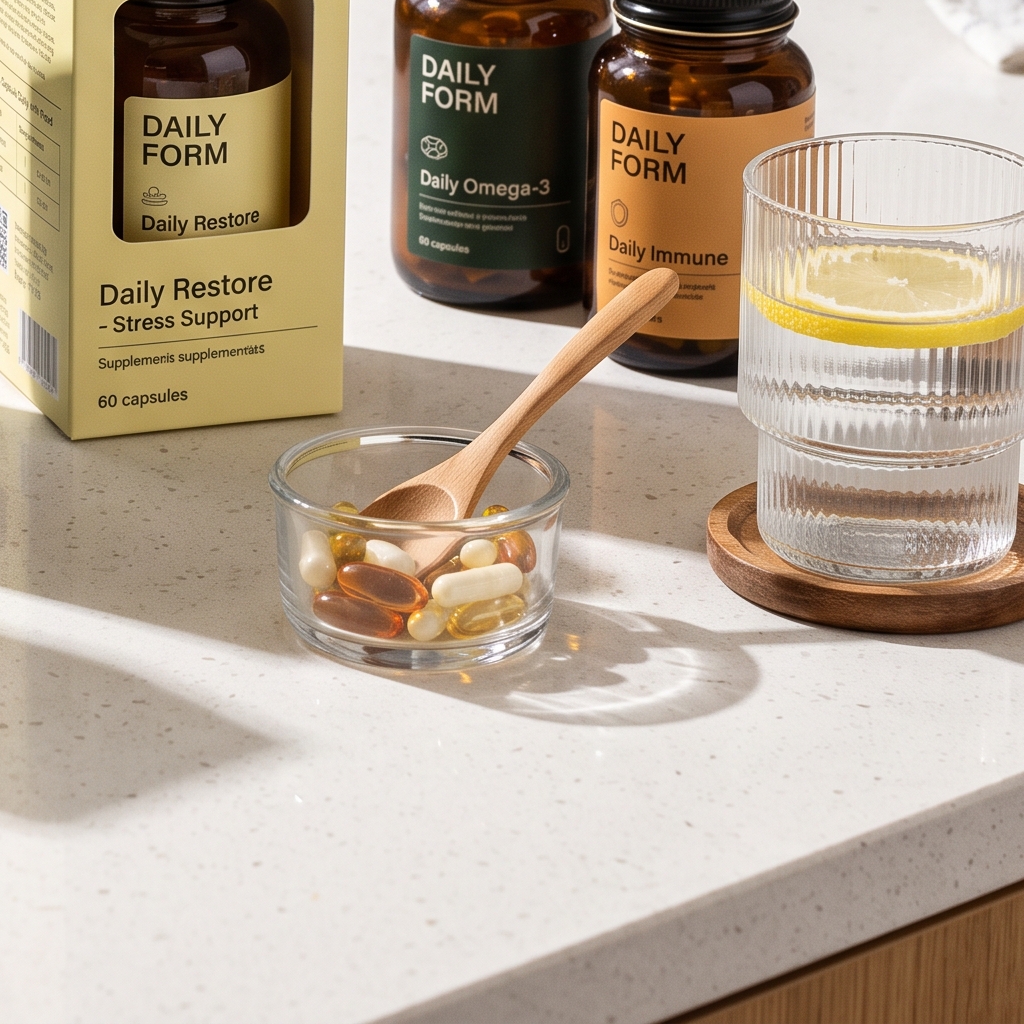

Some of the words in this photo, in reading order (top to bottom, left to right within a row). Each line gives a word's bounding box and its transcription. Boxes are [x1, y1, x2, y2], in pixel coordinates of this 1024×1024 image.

[421, 53, 496, 86] DAILY
[421, 81, 498, 114] FORM
[143, 113, 227, 138] DAILY
[612, 120, 685, 155] DAILY
[142, 141, 227, 167] FORM
[611, 149, 687, 184] FORM
[420, 169, 459, 196] Daily
[463, 178, 551, 201] Omega-3
[141, 214, 188, 236] Daily
[194, 210, 260, 231] Restore
[609, 234, 646, 263] Daily
[651, 245, 729, 266] Immune
[100, 280, 165, 309] Daily
[173, 274, 273, 301] Restore
[113, 315, 175, 333] Stress
[180, 303, 259, 329] Support
[98, 394, 118, 409] 60
[121, 388, 188, 408] capsules
